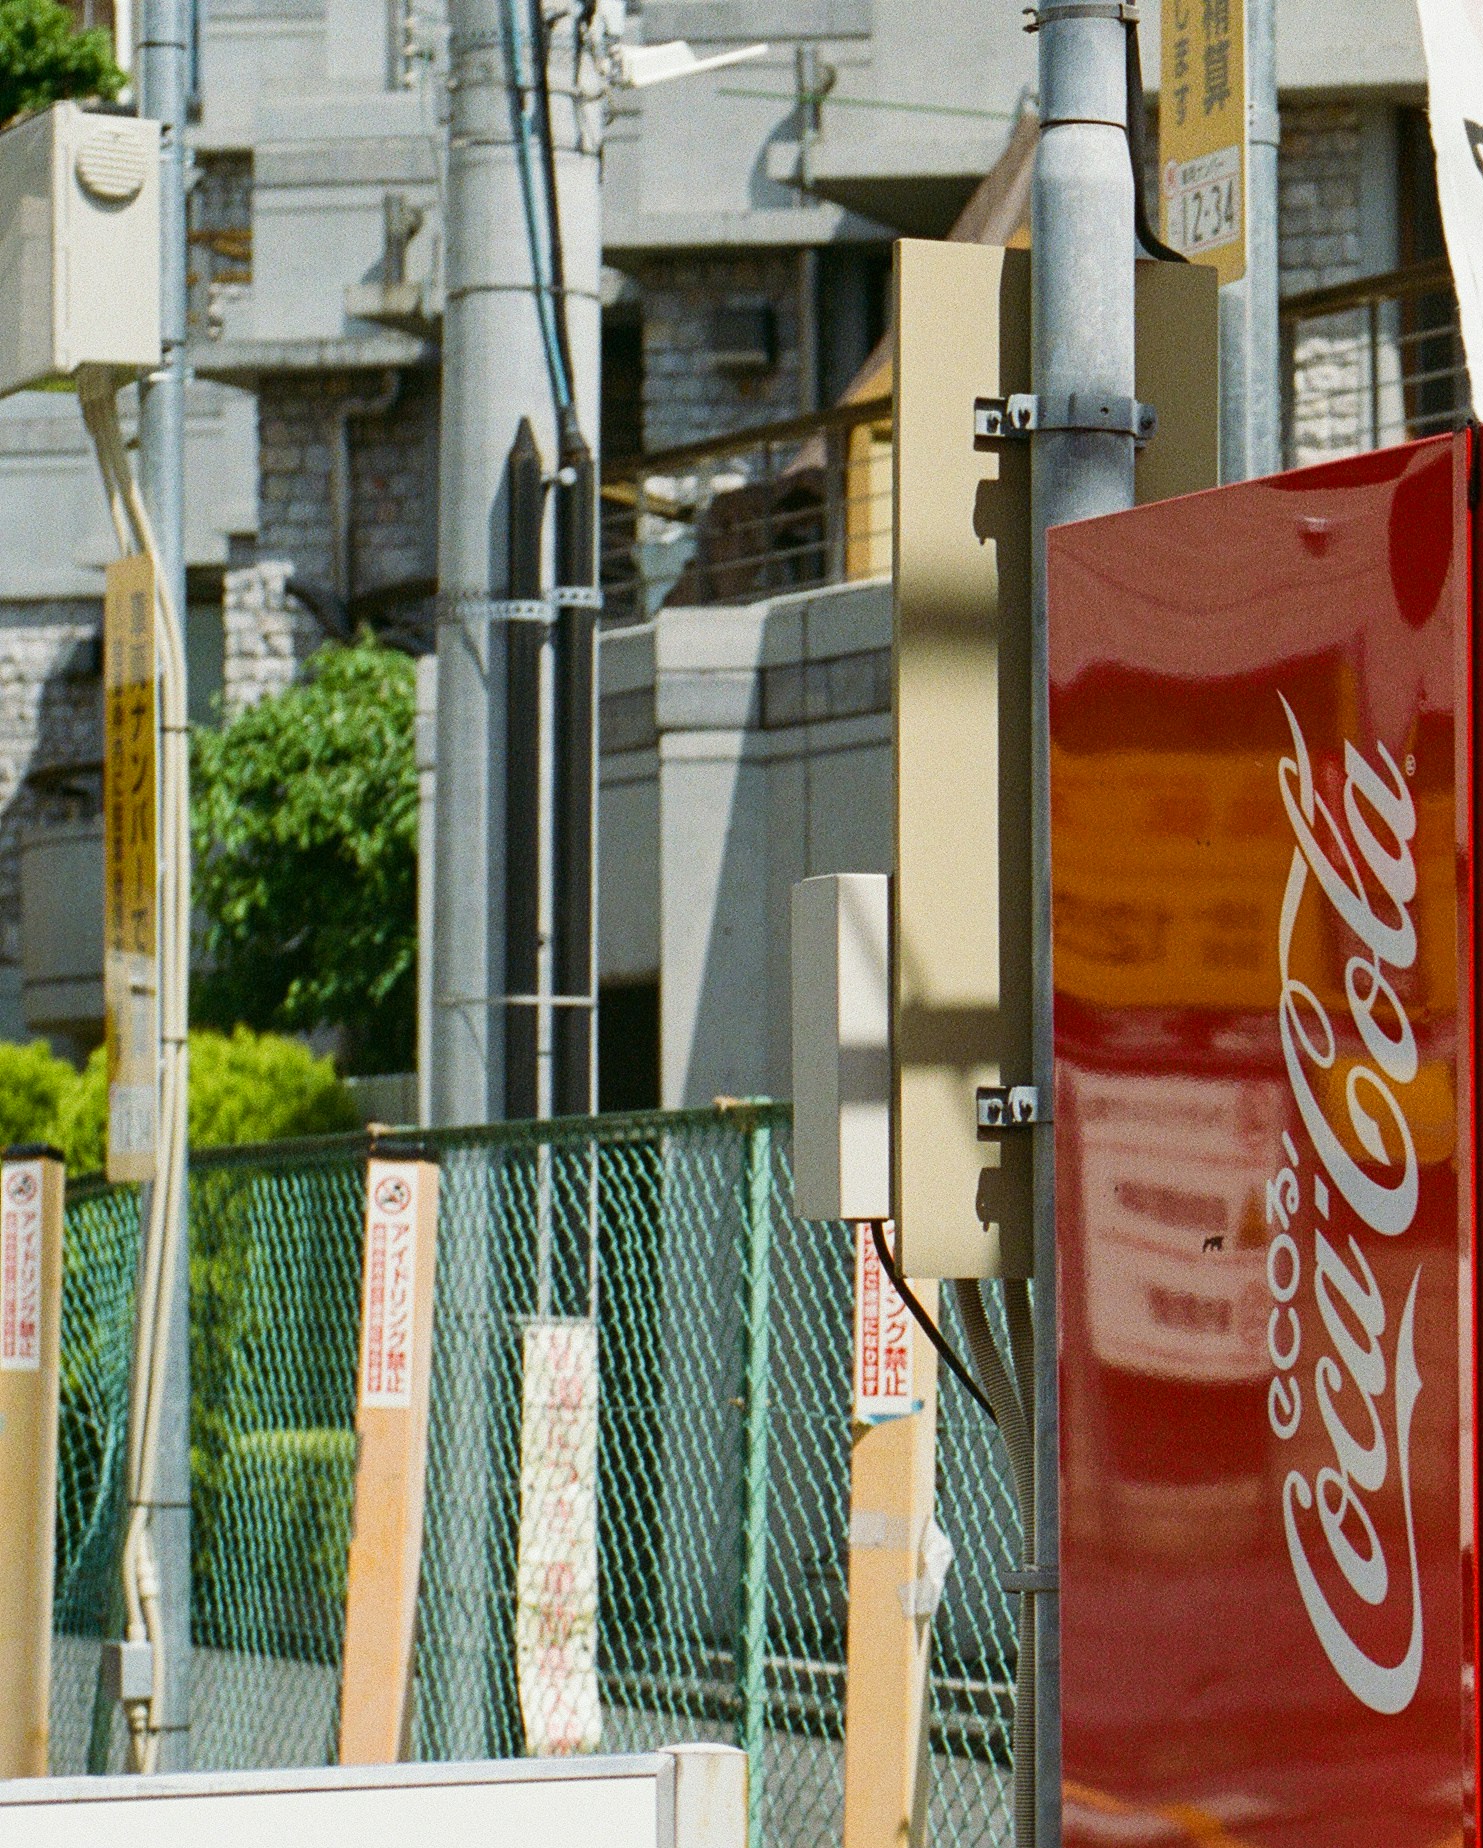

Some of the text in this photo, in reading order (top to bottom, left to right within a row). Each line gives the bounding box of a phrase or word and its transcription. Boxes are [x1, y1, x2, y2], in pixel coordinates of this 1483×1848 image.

[387, 1222, 411, 1393] アイドリング禁止
